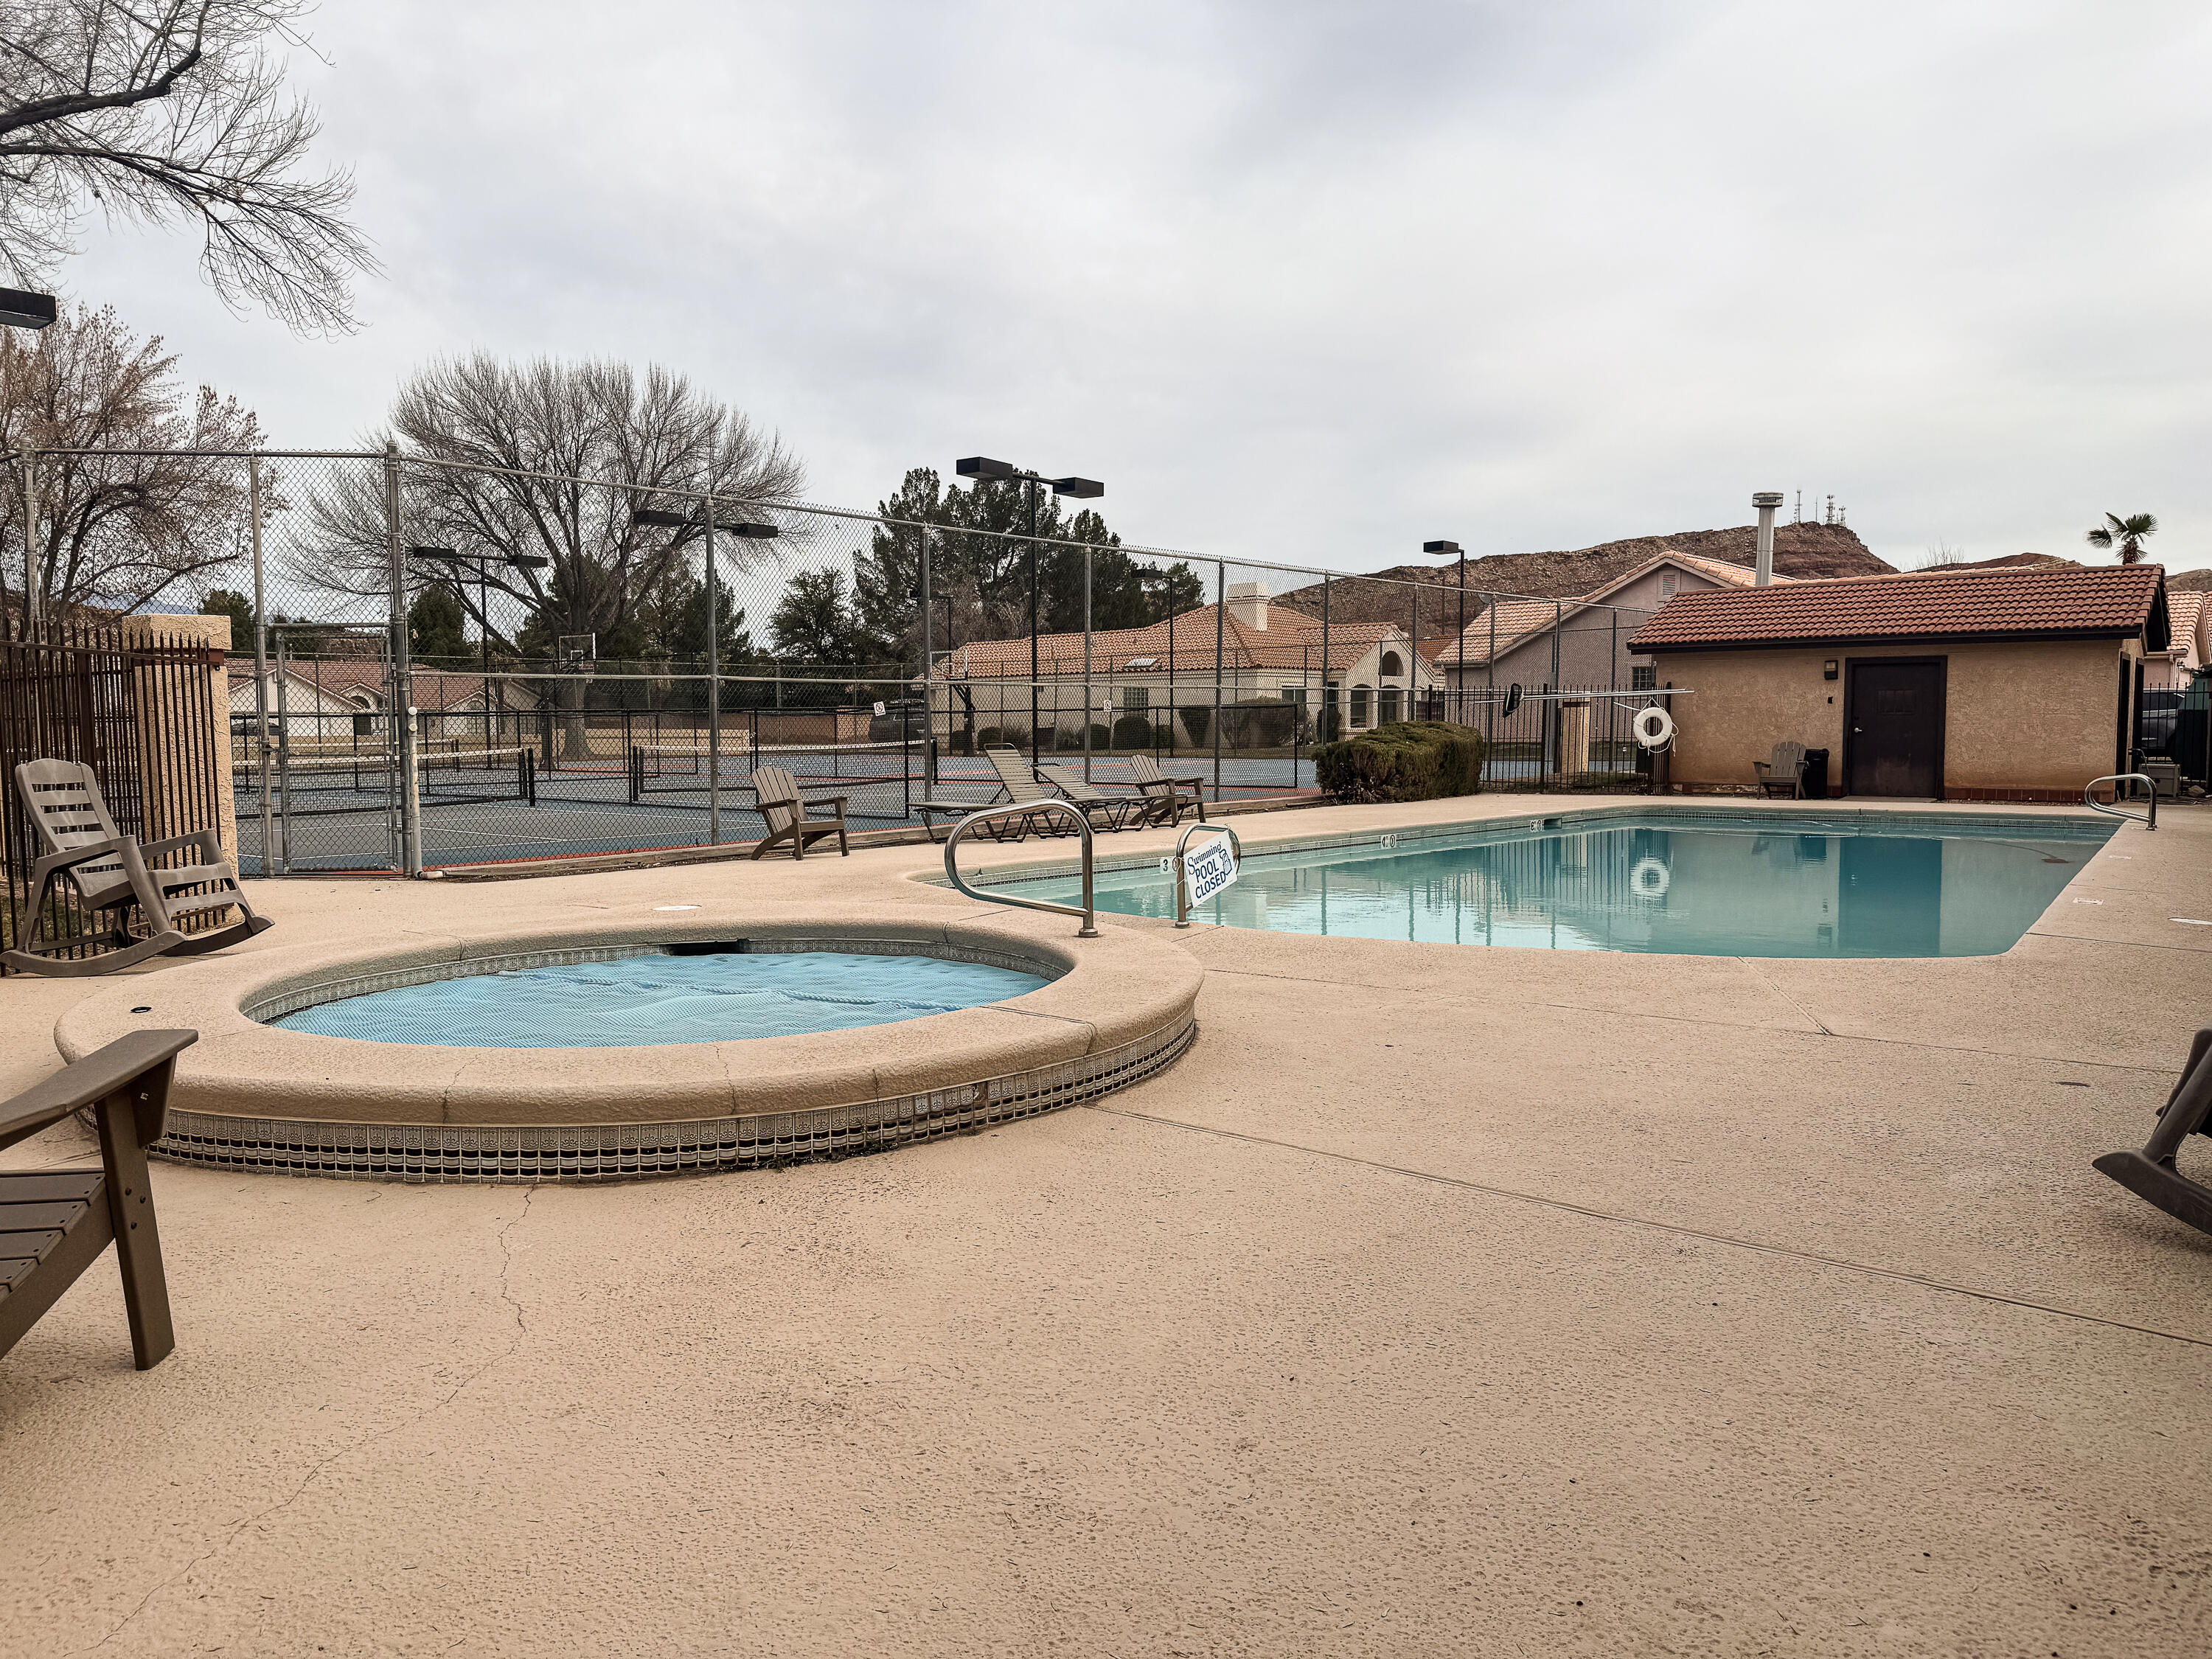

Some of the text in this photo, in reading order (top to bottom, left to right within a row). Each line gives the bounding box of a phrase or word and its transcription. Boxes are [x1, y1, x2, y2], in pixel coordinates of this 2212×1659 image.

[1163, 858, 1168, 872] 3
[1187, 841, 1222, 875] Swimming
[1195, 858, 1219, 883] POOL
[1195, 871, 1226, 899] CLOSED
